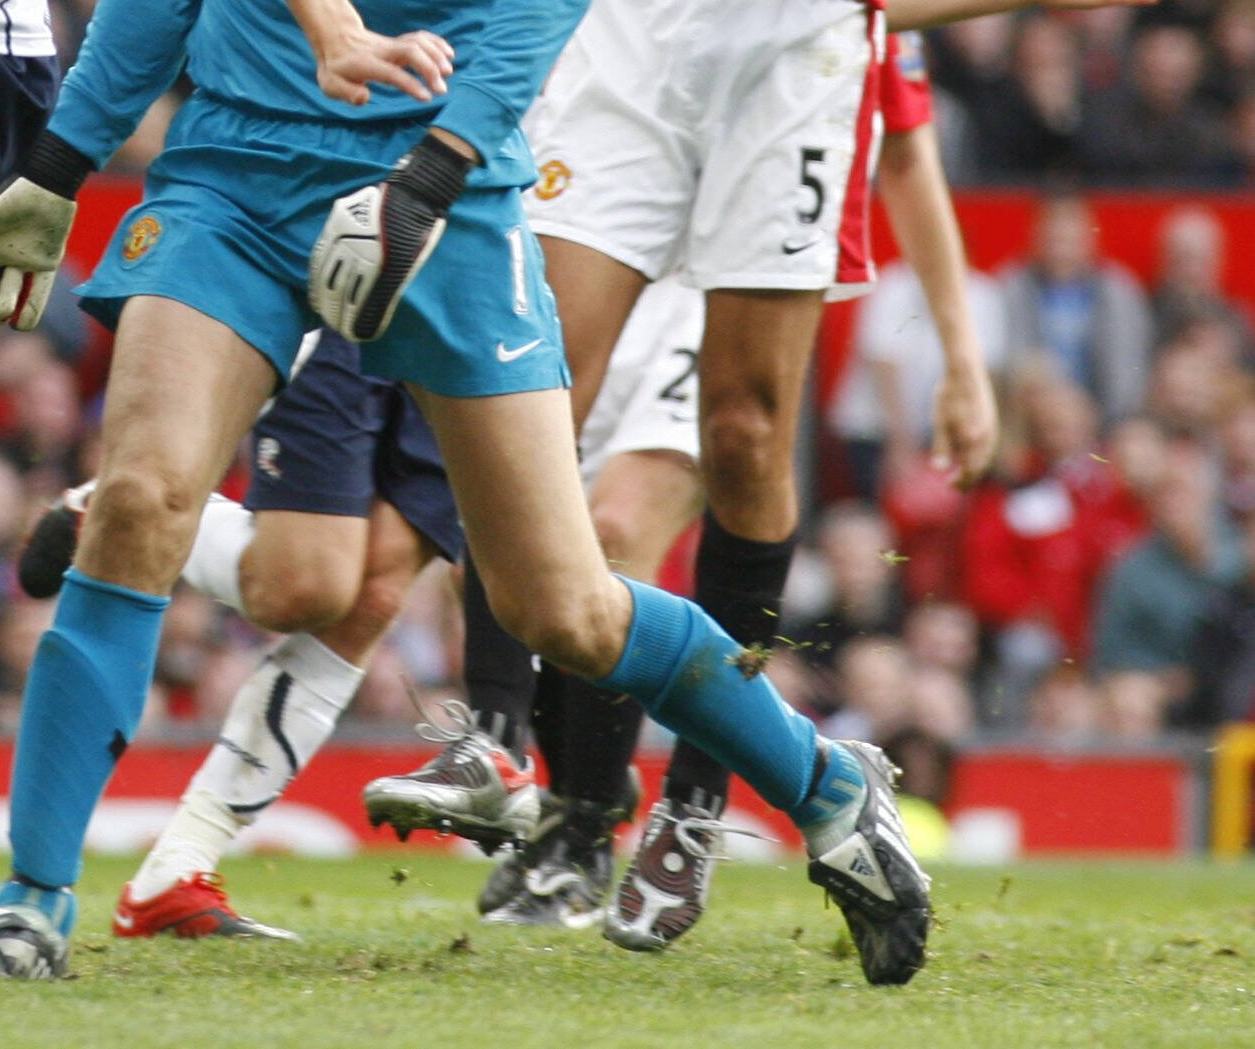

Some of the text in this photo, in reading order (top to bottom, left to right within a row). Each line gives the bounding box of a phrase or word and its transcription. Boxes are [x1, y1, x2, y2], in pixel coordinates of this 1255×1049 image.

[795, 146, 826, 225] 5
[504, 224, 530, 316] 1
[657, 347, 699, 402] 2
